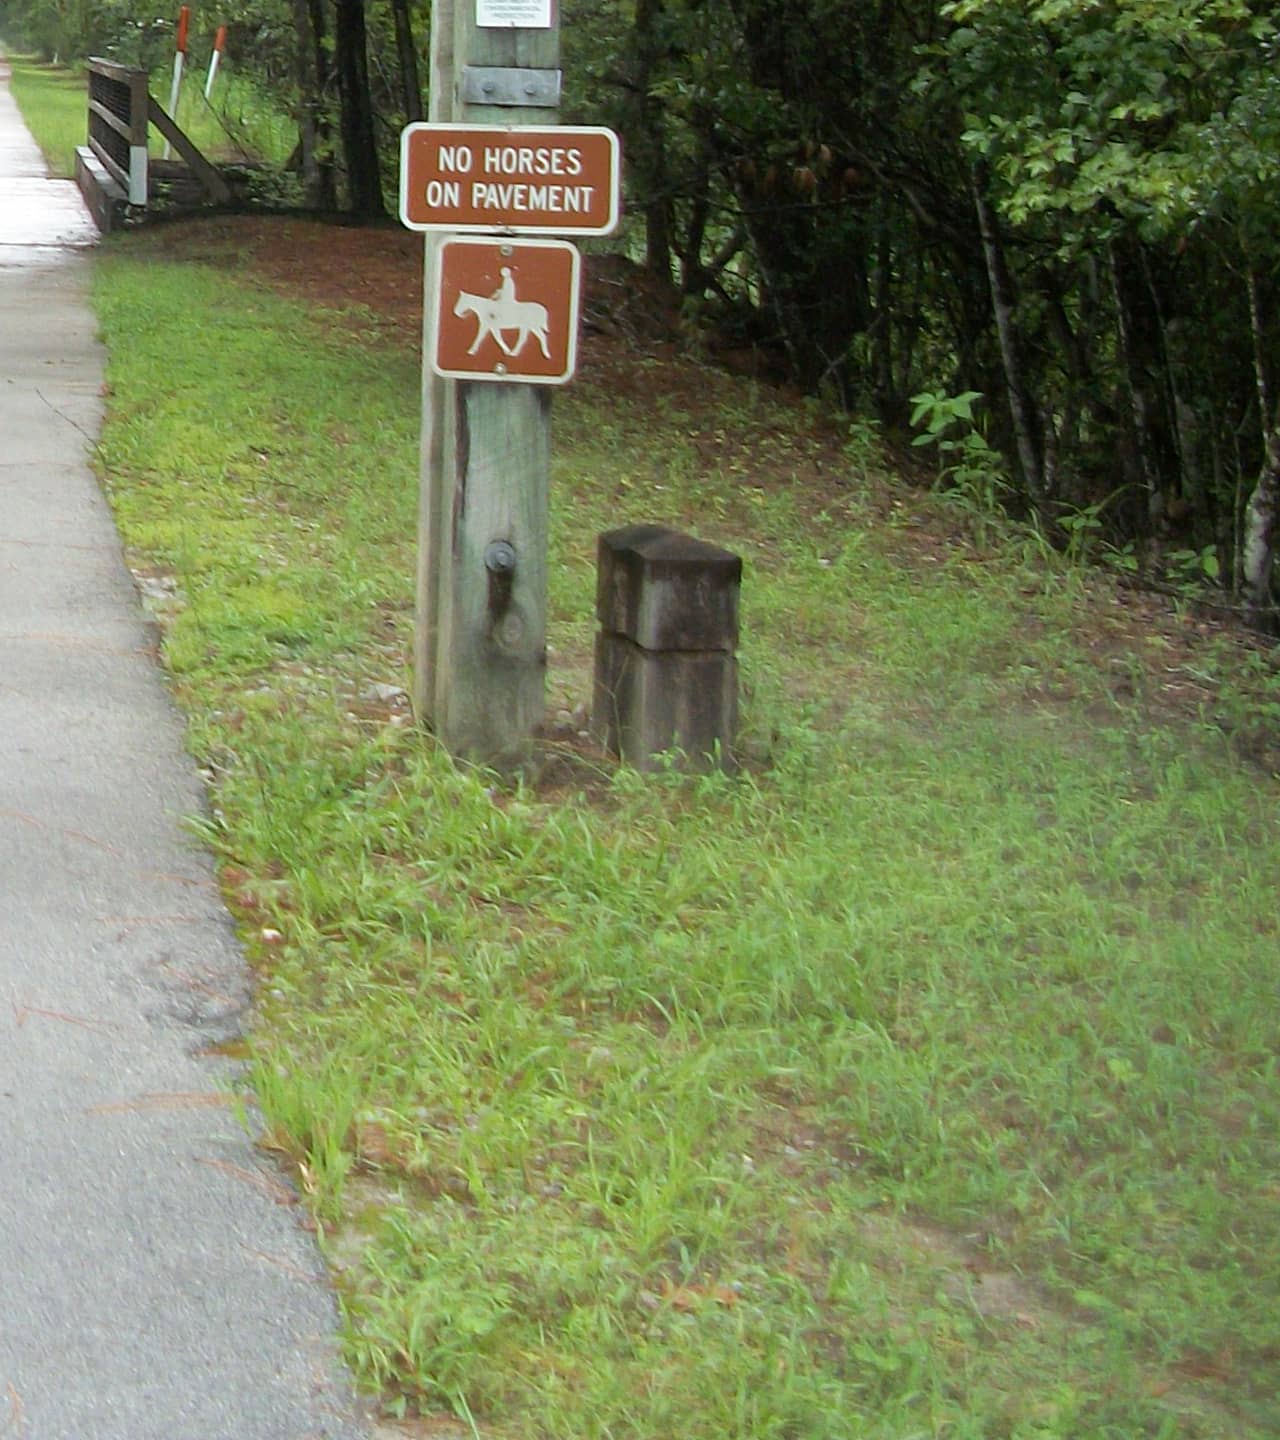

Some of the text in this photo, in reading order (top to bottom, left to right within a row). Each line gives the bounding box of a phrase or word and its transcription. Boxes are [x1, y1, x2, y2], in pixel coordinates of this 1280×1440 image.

[438, 146, 582, 175] NO HORSES
[426, 181, 594, 212] ON PAVEMENT
